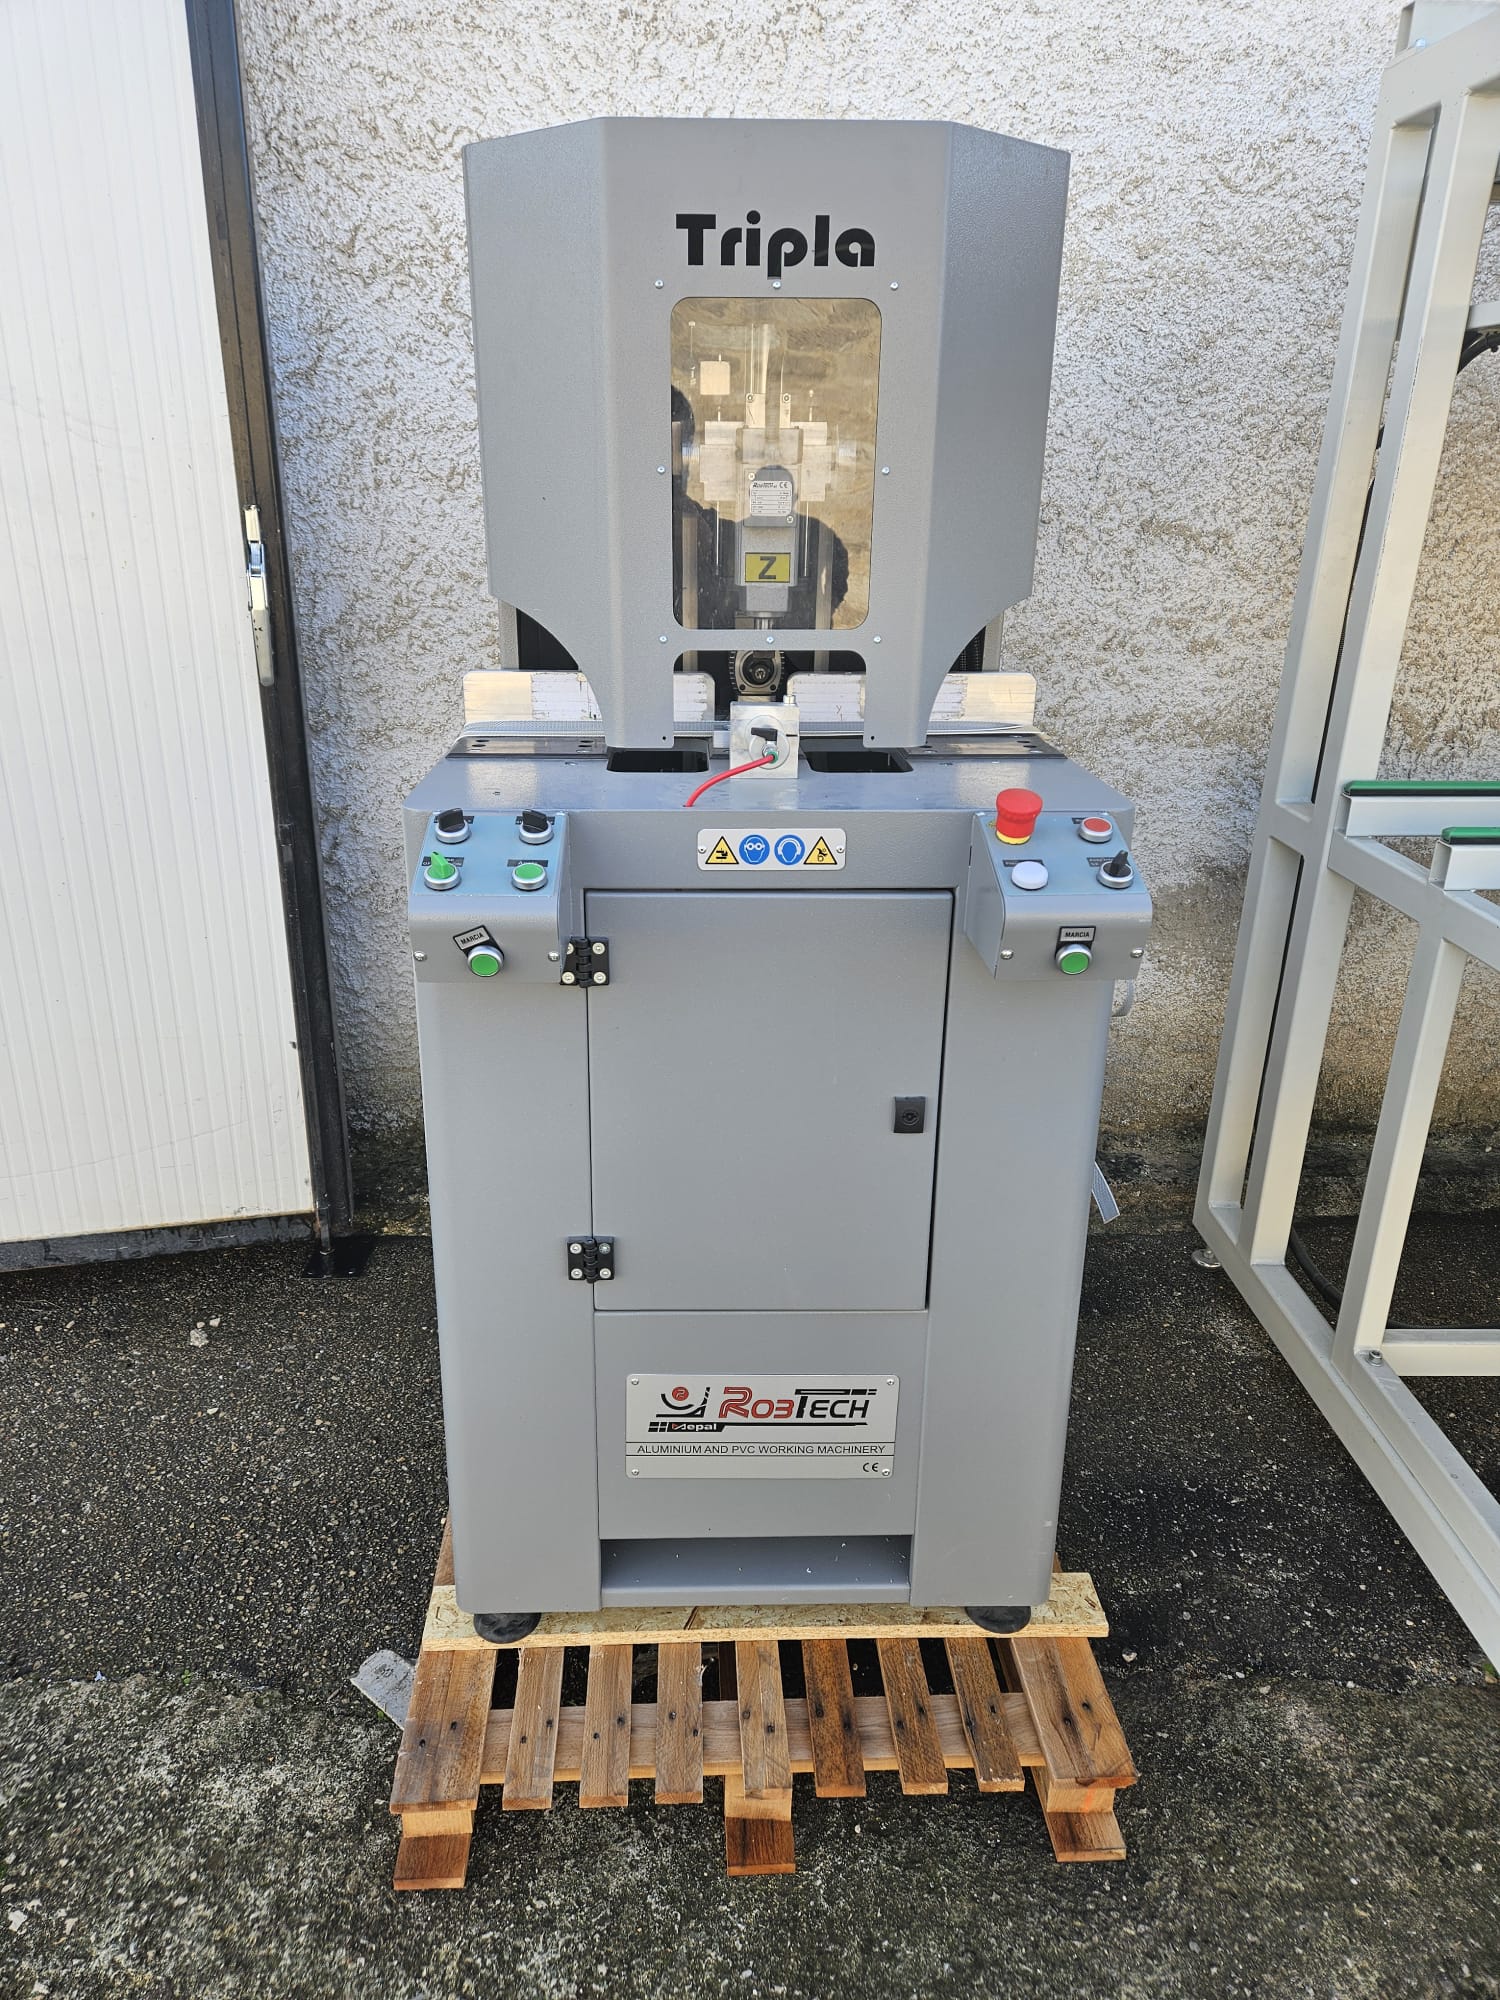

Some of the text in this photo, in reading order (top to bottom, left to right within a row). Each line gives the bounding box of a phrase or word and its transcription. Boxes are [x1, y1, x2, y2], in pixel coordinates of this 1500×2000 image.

[676, 210, 875, 279] Tripla
[758, 555, 777, 580] Z
[460, 932, 485, 944] MARCIA
[637, 1445, 886, 1454] ALUMINIUM AND PVC WORKING MACHINERY
[862, 1462, 879, 1473] CE
